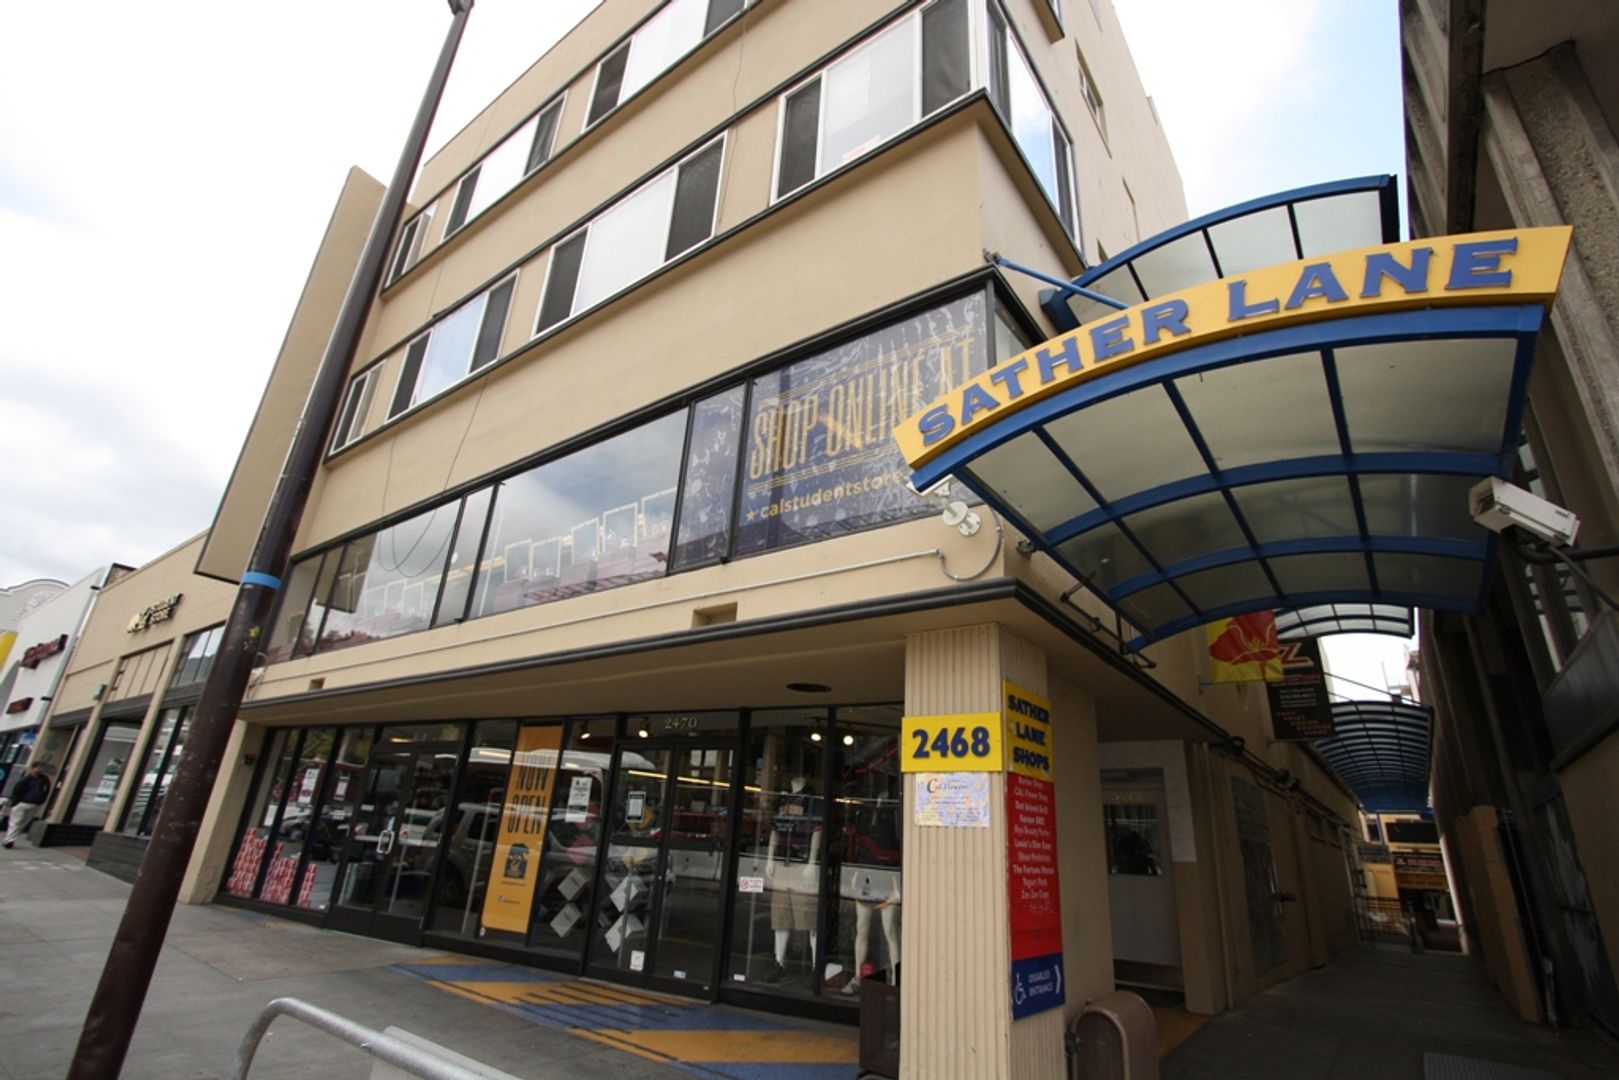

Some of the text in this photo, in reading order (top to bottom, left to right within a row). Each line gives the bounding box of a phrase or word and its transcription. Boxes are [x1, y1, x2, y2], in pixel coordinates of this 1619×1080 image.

[918, 236, 1519, 446] SATHER LANE
[750, 396, 819, 480] SHOP
[826, 353, 926, 457] ONLINE
[664, 716, 698, 729] 2470
[1008, 694, 1050, 724] SATHER
[911, 725, 990, 758] 2468
[1016, 721, 1046, 747] LANE
[1013, 746, 1050, 773] SHOPS
[507, 794, 547, 834] OPEN
